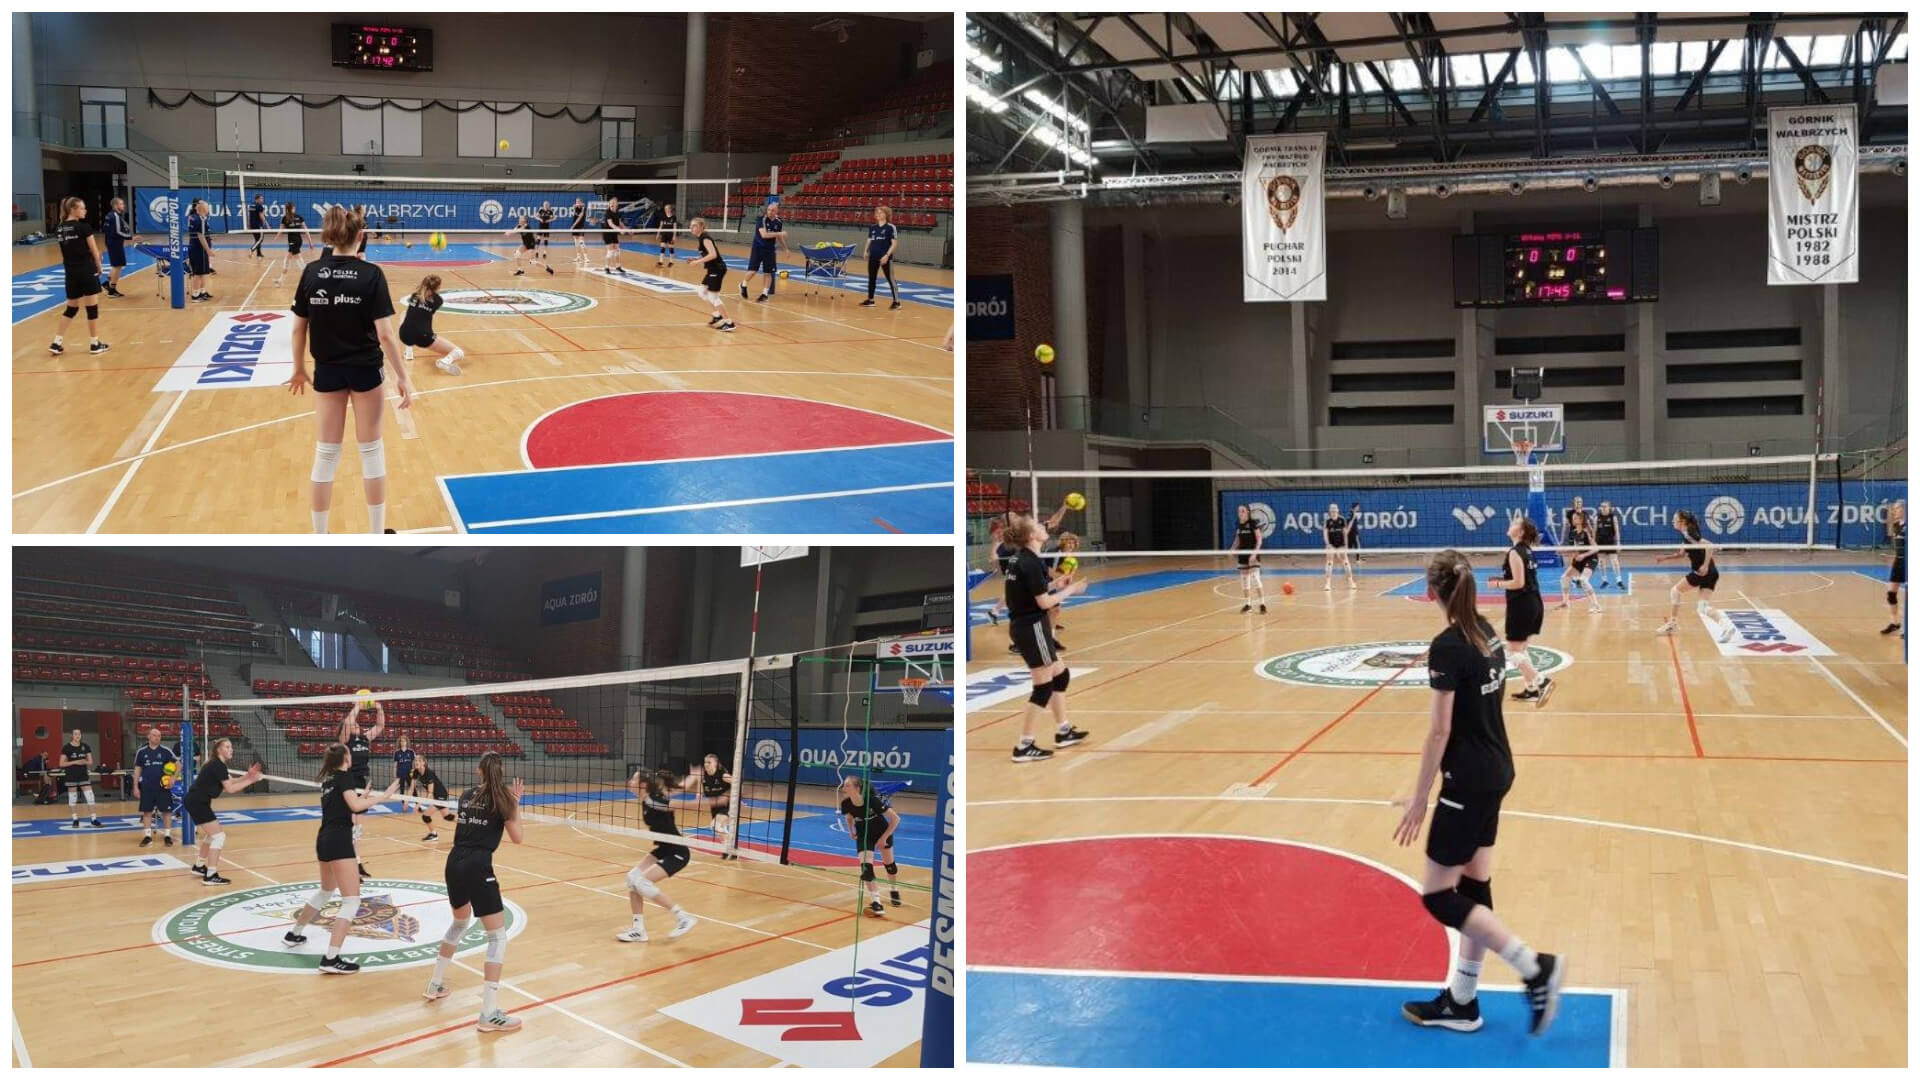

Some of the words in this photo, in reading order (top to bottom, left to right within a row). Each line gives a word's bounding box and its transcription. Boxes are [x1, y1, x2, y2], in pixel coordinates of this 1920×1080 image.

[1789, 114, 1834, 125] GÓRNIK
[1776, 127, 1848, 138] WAŁBRZYCH
[1787, 213, 1838, 225] MISTRZ
[168, 196, 181, 260] PESMENPOL
[1787, 227, 1838, 239] POLSKI
[1263, 242, 1305, 251] PUCHAR
[1796, 240, 1831, 252] 1982
[1267, 255, 1303, 263] POLSKI
[1530, 249, 1539, 262] 0
[1566, 248, 1576, 261] 0
[1796, 254, 1831, 266] 1988
[197, 323, 271, 384] SUZUKI
[1508, 410, 1553, 420] SUZUKI
[1753, 506, 1819, 528] AQUA
[845, 746, 911, 768] ZDRÓJ
